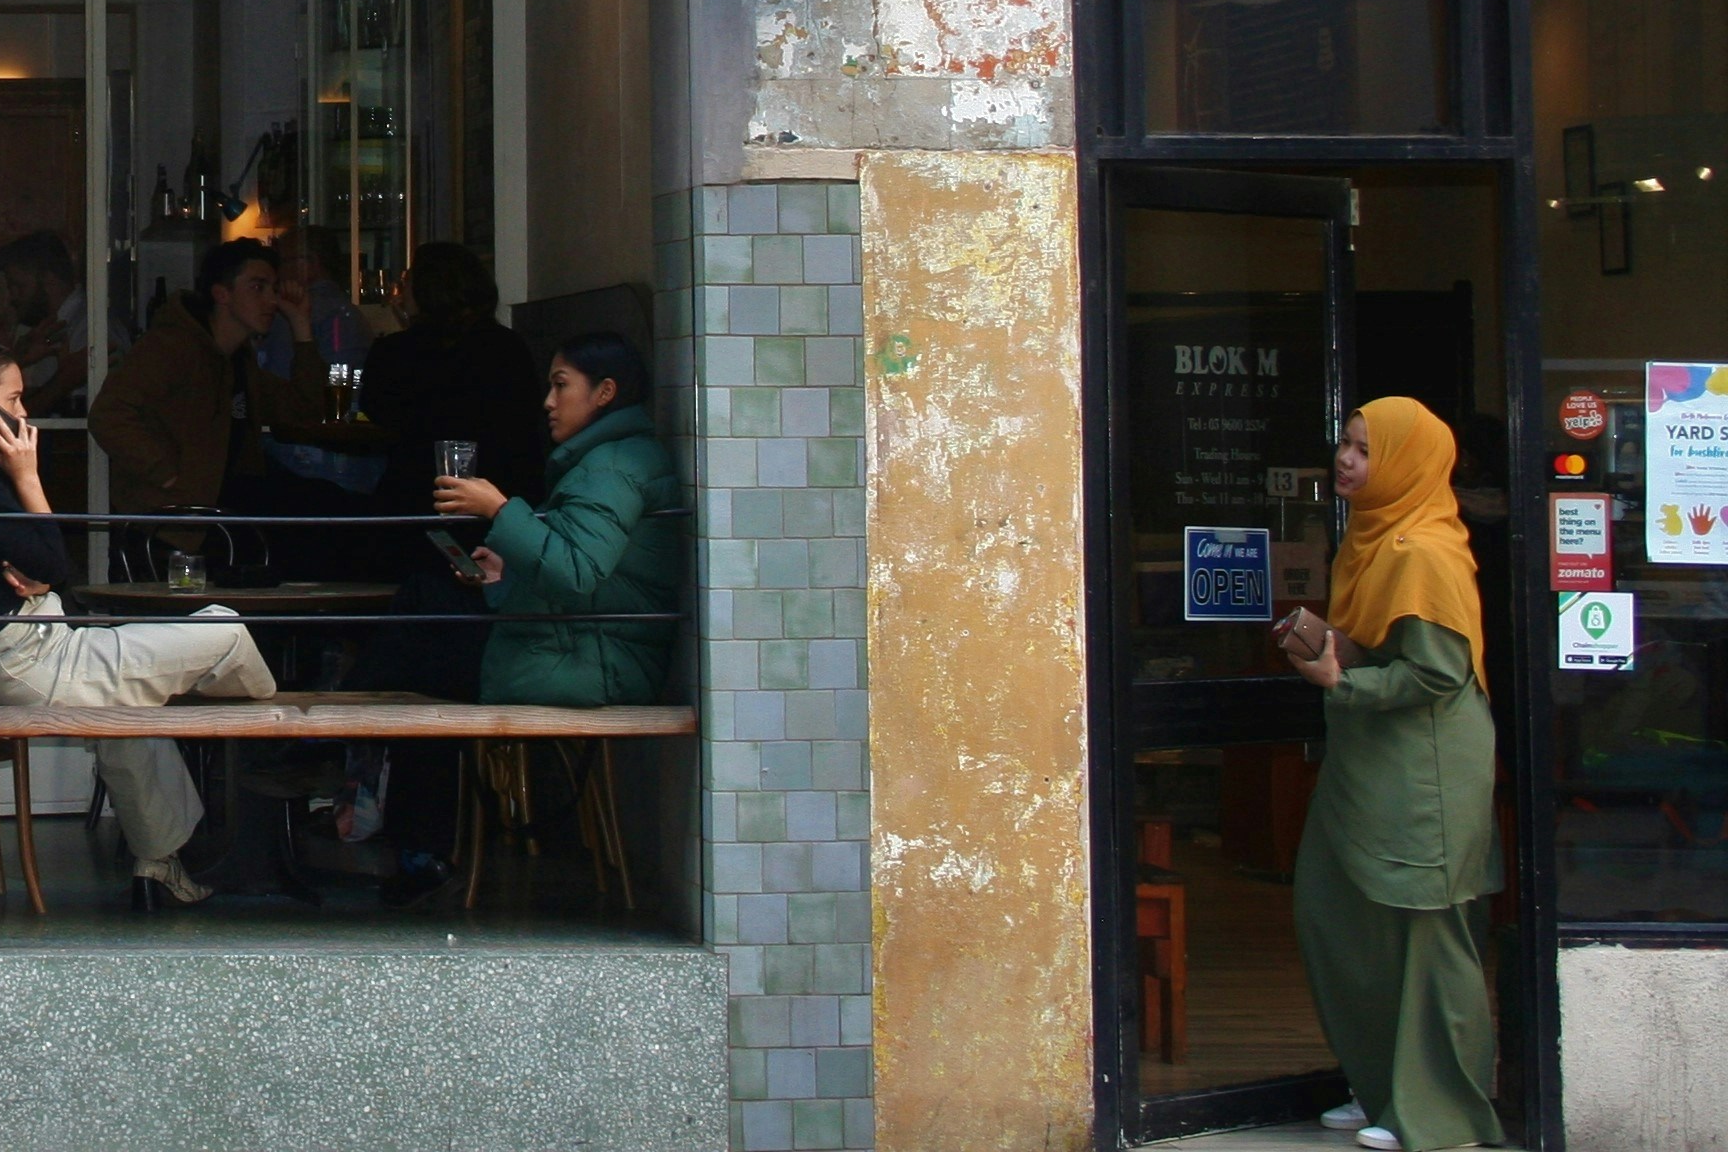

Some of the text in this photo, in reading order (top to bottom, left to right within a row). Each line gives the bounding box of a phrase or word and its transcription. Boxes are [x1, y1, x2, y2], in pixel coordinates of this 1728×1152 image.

[1174, 345, 1280, 377] BLOK M
[1175, 381, 1280, 398] EXPRESS
[1565, 415, 1590, 430] yelp
[1665, 425, 1714, 440] YARD
[1670, 444, 1683, 457] for
[1558, 508, 1578, 516] best
[1558, 518, 1582, 527] thing
[1558, 528, 1574, 536] the
[1558, 568, 1605, 579] zomato
[1191, 567, 1265, 606] OPEN
